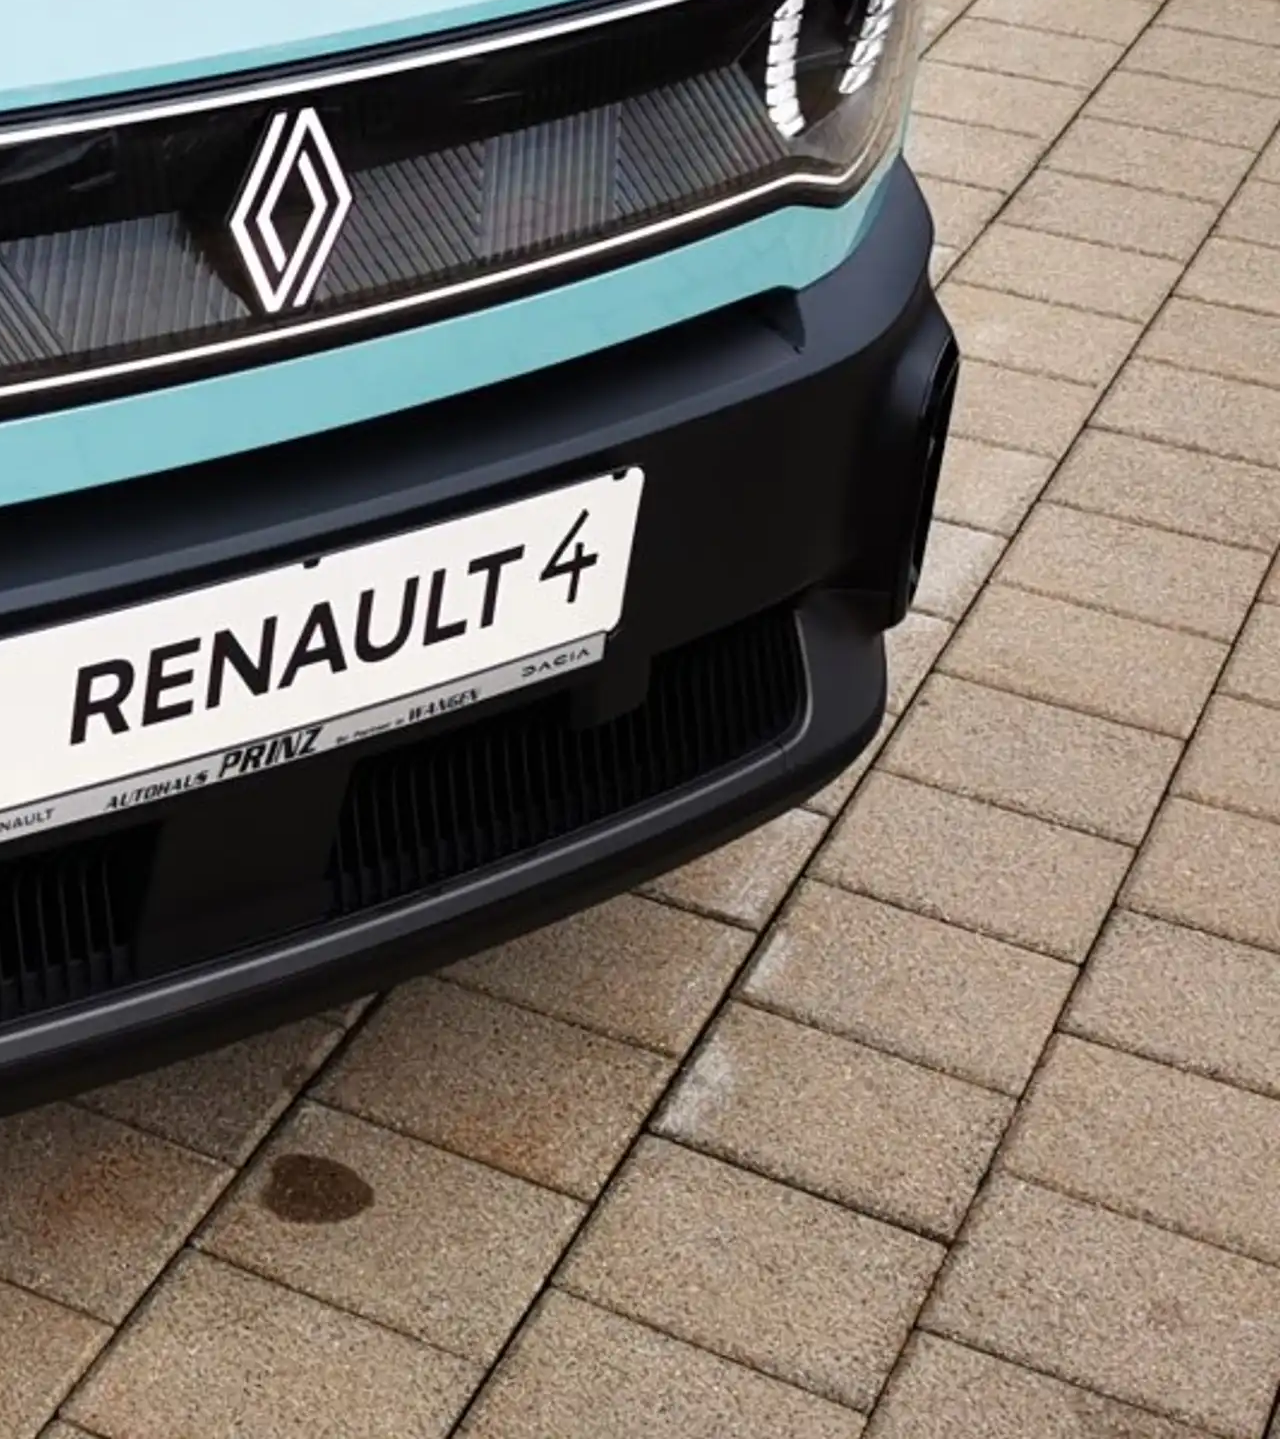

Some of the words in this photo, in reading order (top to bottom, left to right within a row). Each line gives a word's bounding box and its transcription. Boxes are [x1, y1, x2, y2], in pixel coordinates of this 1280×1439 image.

[70, 543, 525, 746] RENAULT
[539, 509, 599, 604] 4
[521, 646, 591, 678] DACIA
[104, 769, 209, 811] AUTOHAUS
[218, 725, 323, 778] PRINZ
[408, 687, 481, 722] WANGEN
